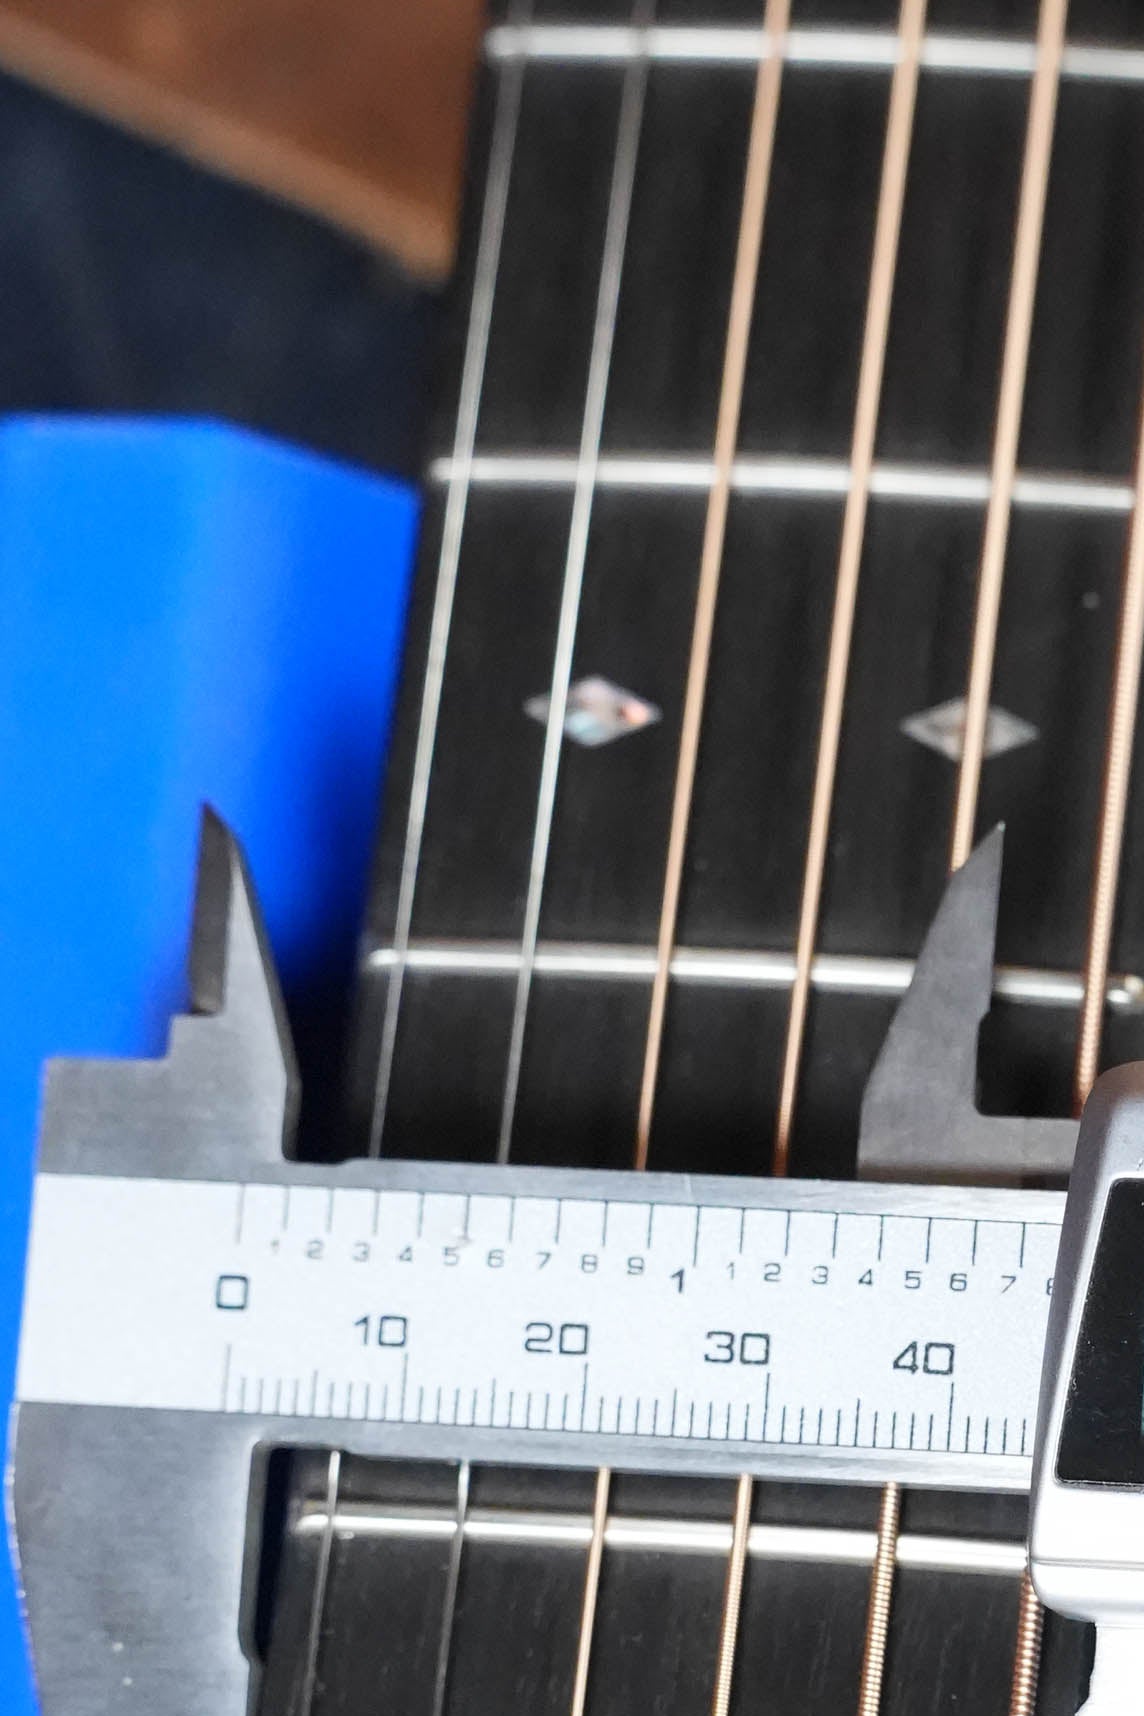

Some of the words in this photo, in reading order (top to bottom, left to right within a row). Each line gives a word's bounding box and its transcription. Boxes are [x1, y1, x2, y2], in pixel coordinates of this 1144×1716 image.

[306, 1239, 324, 1260] 2
[352, 1241, 370, 1263] 3
[398, 1246, 414, 1264] 4
[442, 1247, 460, 1266] 5
[487, 1248, 505, 1269] 6
[536, 1252, 551, 1270] 7
[581, 1254, 599, 1274] 8
[627, 1256, 644, 1275] 9
[670, 1268, 685, 1294] 1
[726, 1261, 736, 1280] 1
[763, 1263, 782, 1282] 2
[811, 1265, 830, 1285] 3
[858, 1268, 875, 1286] 4
[904, 1271, 922, 1290] 5
[949, 1272, 968, 1292] 6
[1000, 1275, 1017, 1294] 7
[215, 1274, 250, 1310] 0
[353, 1315, 408, 1347] 10
[524, 1321, 589, 1355] 20
[704, 1330, 771, 1365] 30
[893, 1341, 956, 1376] 40
